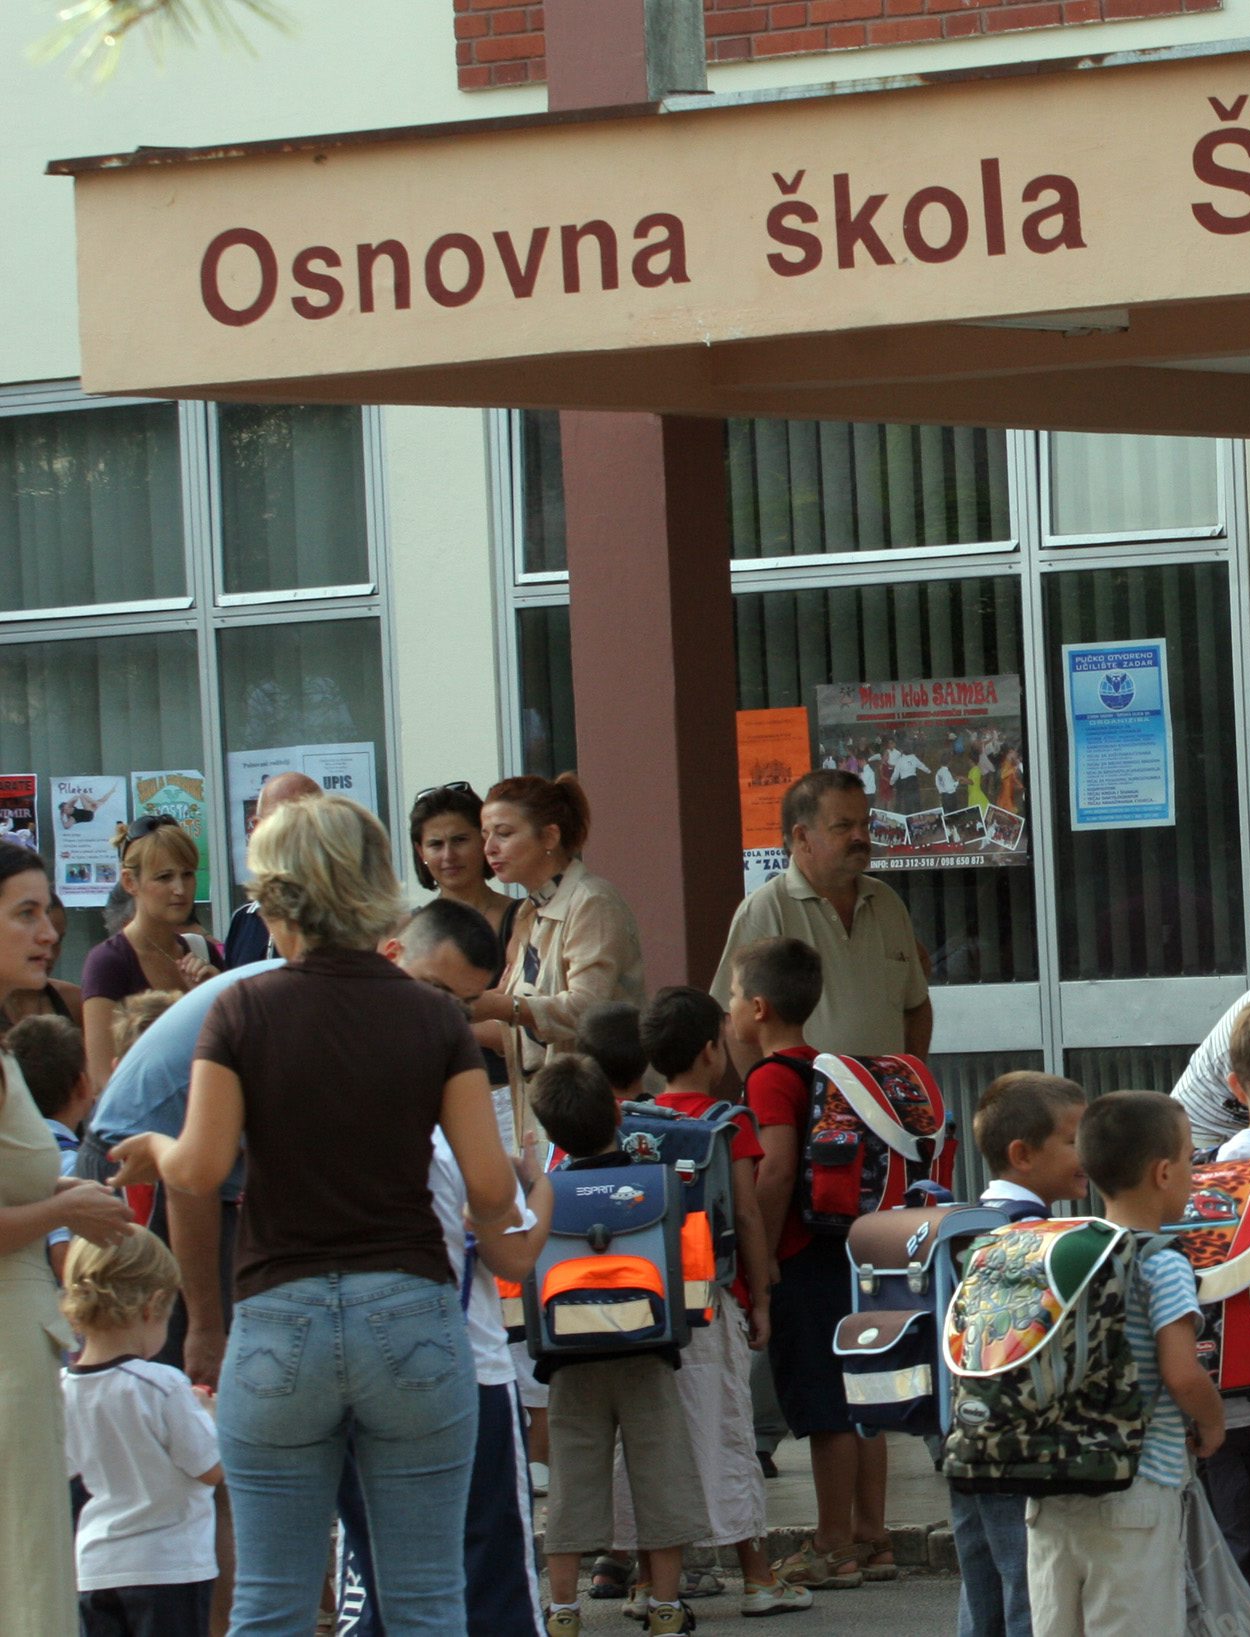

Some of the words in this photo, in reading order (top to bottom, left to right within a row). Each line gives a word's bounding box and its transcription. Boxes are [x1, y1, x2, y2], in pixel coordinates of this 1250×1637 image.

[200, 213, 691, 327] Osnovna
[766, 157, 1088, 277] škola
[1075, 654, 1105, 663] PUČKO
[1107, 651, 1153, 661] OTVORENO
[1075, 661, 1118, 671] UČILIŠTE
[1122, 659, 1153, 668] ZADAR
[932, 680, 999, 707] SAMBA
[58, 782, 94, 794] Pilates
[323, 775, 353, 790] UPIS
[890, 858, 904, 868] 023
[905, 857, 935, 868] 312-518
[941, 856, 955, 867] 098
[956, 856, 969, 866] 650
[971, 855, 985, 865] 873
[575, 1184, 616, 1197] ESPRIT
[905, 1220, 930, 1258] 23
